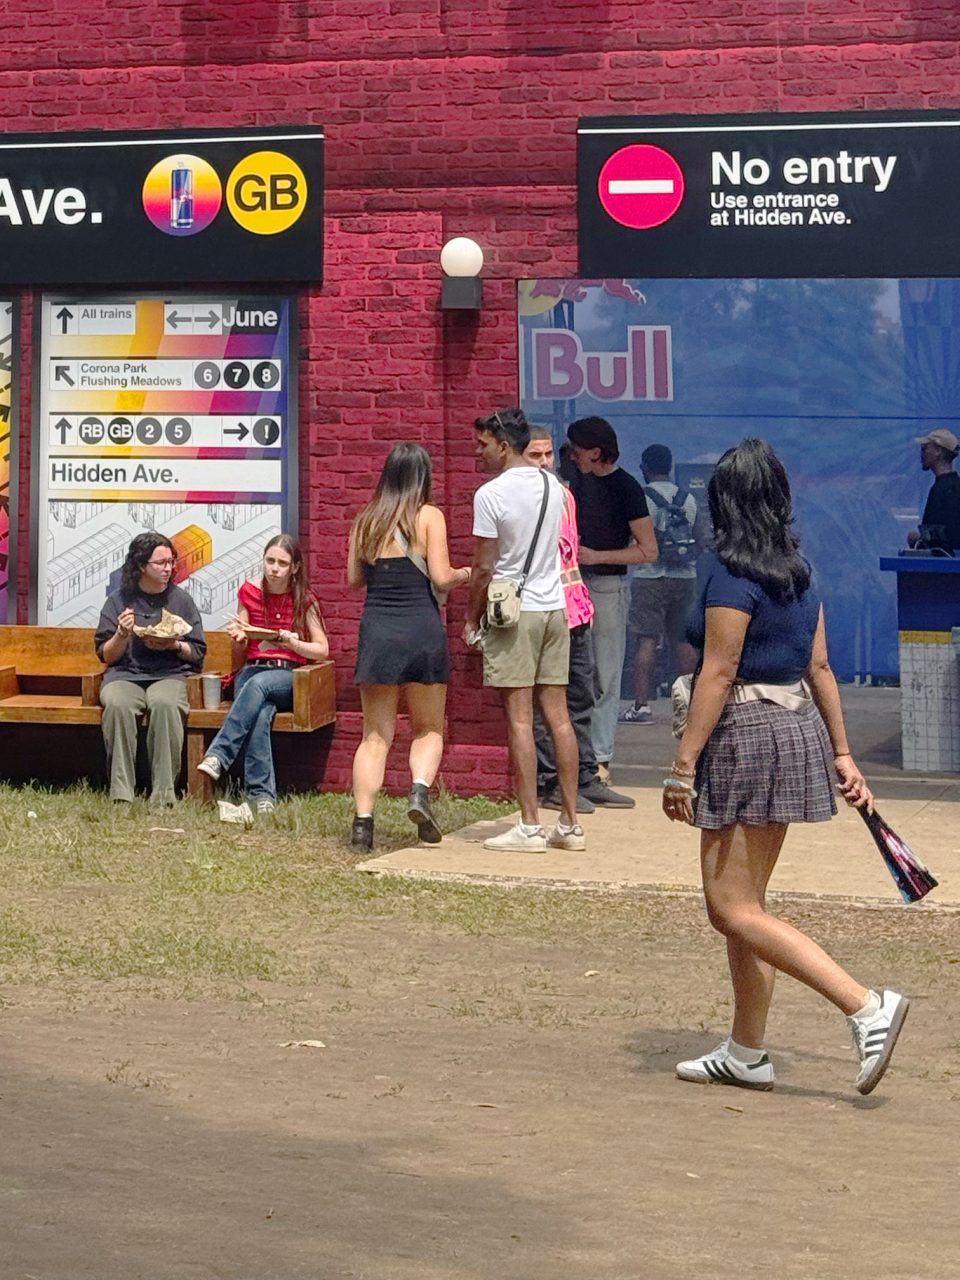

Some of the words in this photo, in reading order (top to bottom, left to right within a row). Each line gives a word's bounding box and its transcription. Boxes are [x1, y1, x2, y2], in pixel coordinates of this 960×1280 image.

[711, 151, 770, 185] No
[783, 150, 897, 192] entry
[233, 173, 300, 212] GB
[710, 192, 748, 208] Use
[753, 193, 839, 208] entrance
[710, 210, 730, 226] at
[734, 209, 804, 226] Hidden
[808, 208, 852, 224] Ave.
[81, 307, 97, 320] All
[99, 307, 132, 320] trains
[222, 306, 278, 327] June
[80, 362, 121, 374] Corona
[123, 362, 147, 373] Park
[533, 326, 672, 402] Bull
[80, 376, 128, 388] Flushing
[130, 376, 182, 387] Meadows
[203, 366, 214, 383] 6
[232, 366, 242, 383] 7
[262, 365, 271, 383] 8
[81, 424, 103, 438] RB
[109, 424, 133, 438] GB
[144, 425, 155, 439] 2
[174, 425, 183, 439] 5
[51, 462, 126, 483] Hidden
[132, 462, 180, 483] Ave.
